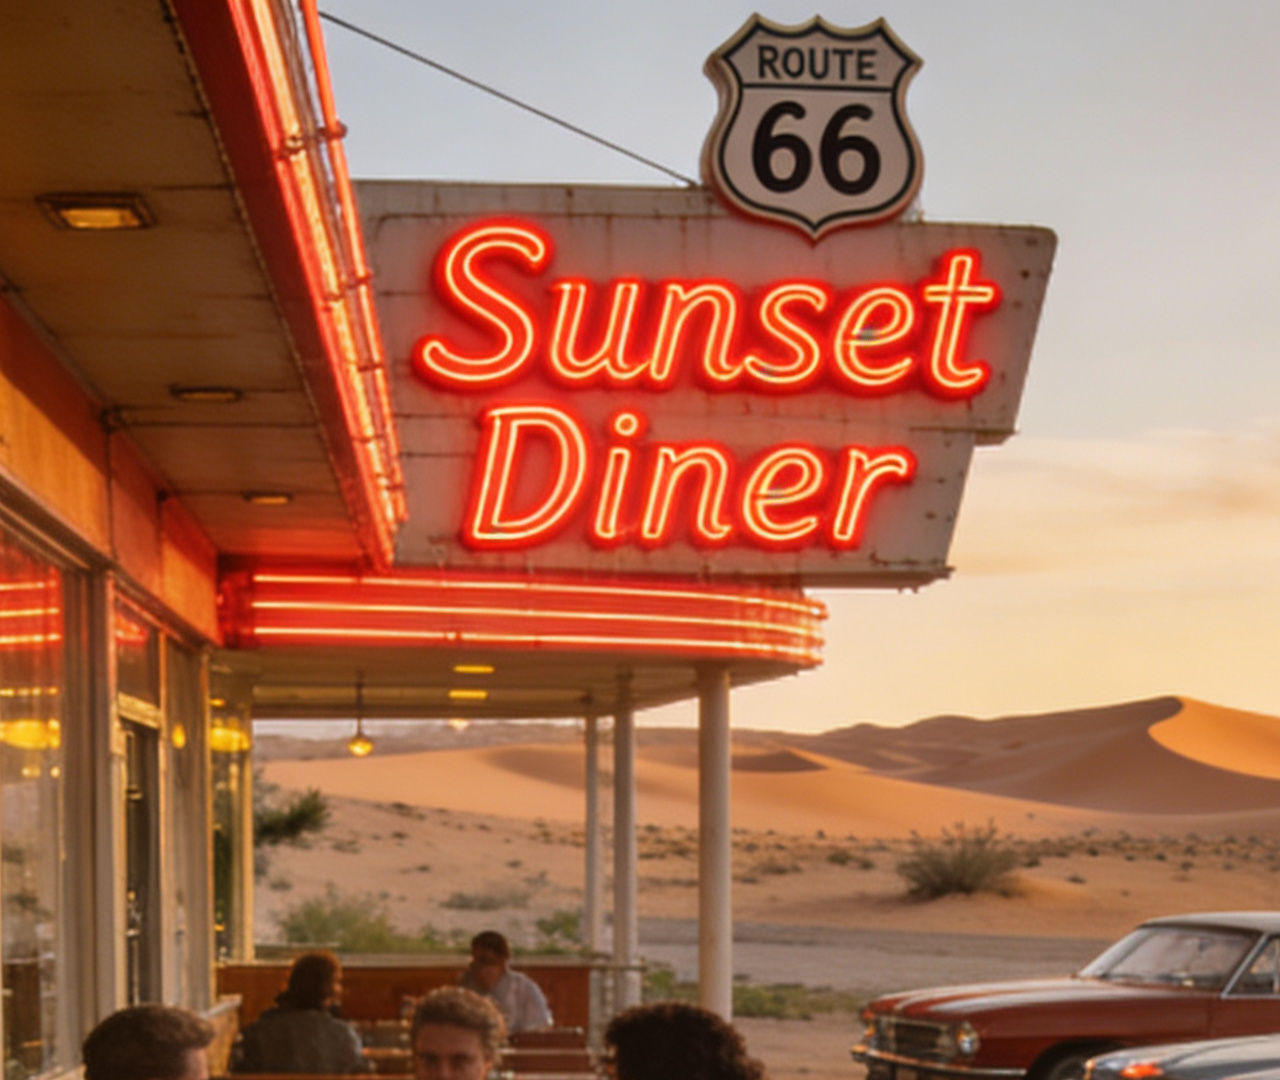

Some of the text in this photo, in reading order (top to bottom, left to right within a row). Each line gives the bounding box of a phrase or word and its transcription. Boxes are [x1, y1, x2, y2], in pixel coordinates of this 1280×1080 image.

[757, 45, 878, 82] ROUTE
[752, 101, 881, 196] 66
[419, 223, 997, 390] Sunset
[468, 402, 912, 544] Diner
